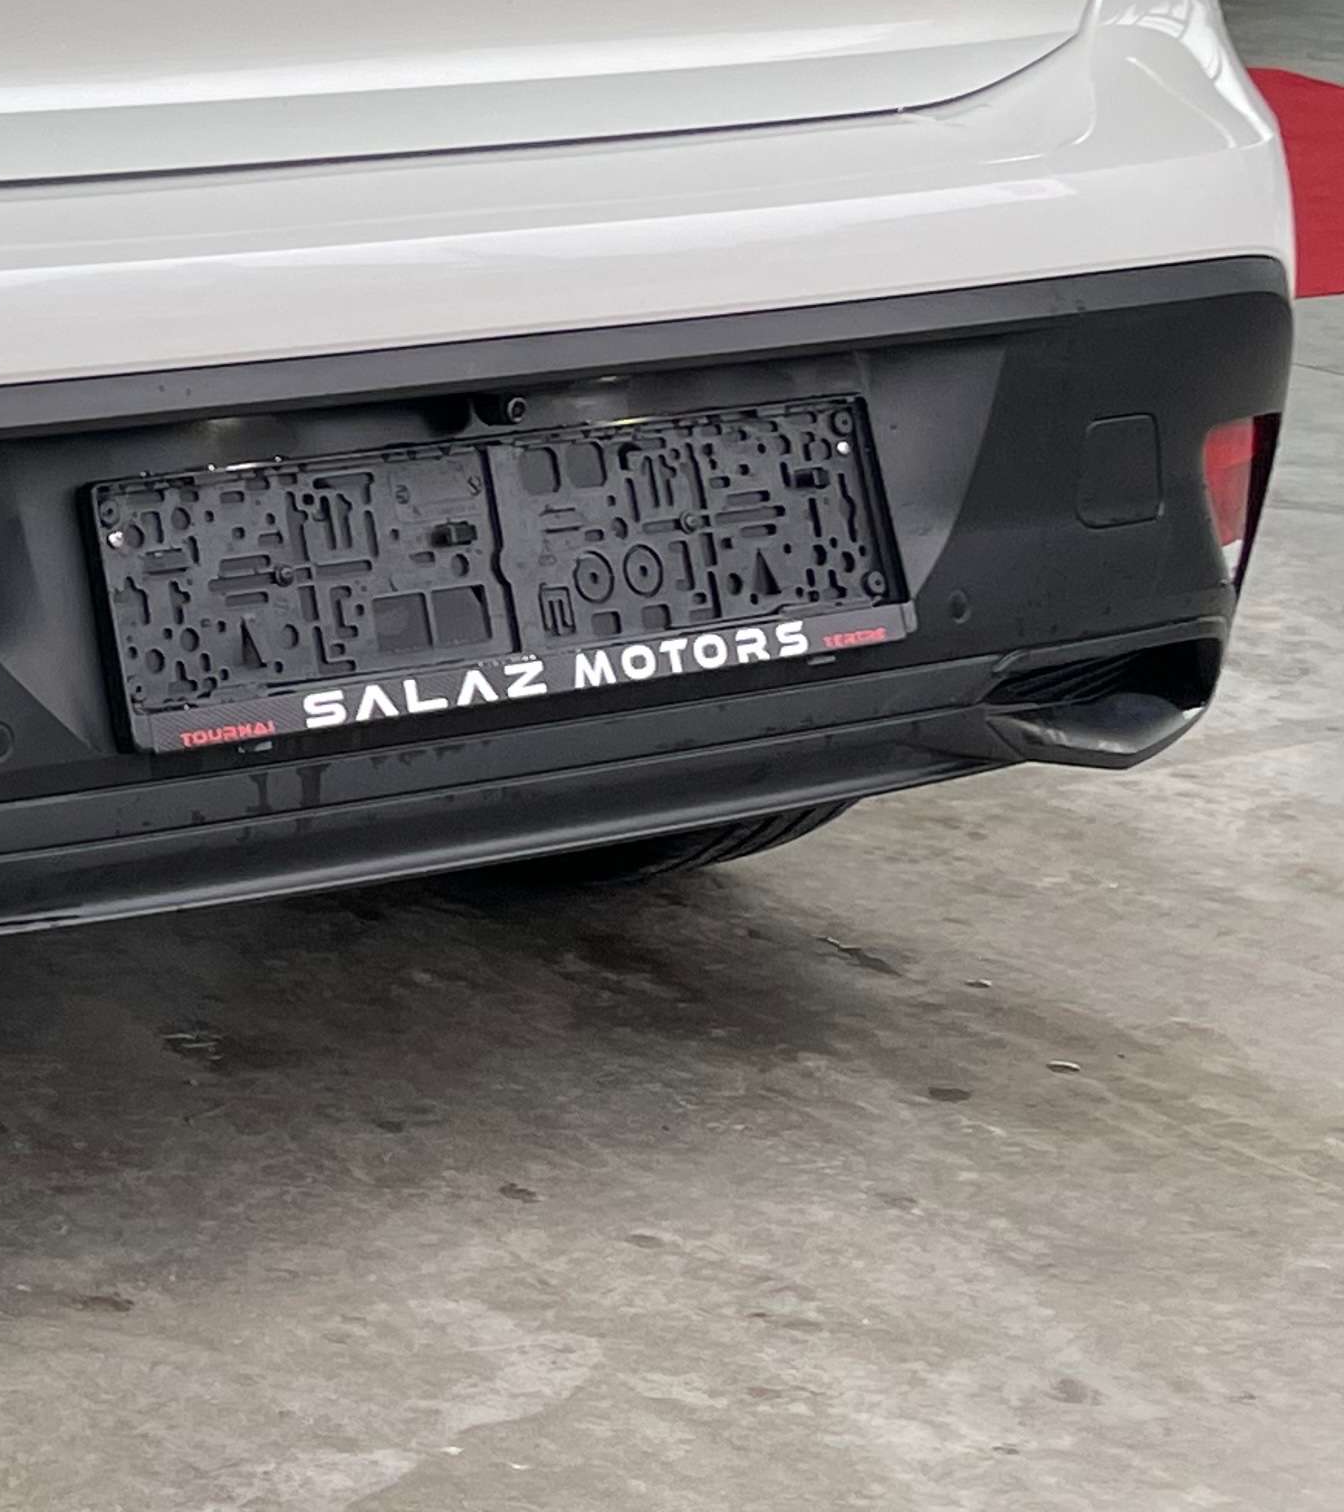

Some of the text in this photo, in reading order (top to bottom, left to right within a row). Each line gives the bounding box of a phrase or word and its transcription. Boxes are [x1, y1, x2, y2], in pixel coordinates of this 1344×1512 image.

[179, 719, 276, 747] TOURNAI
[303, 659, 548, 729] SALAZ
[574, 620, 809, 688] MOTORS
